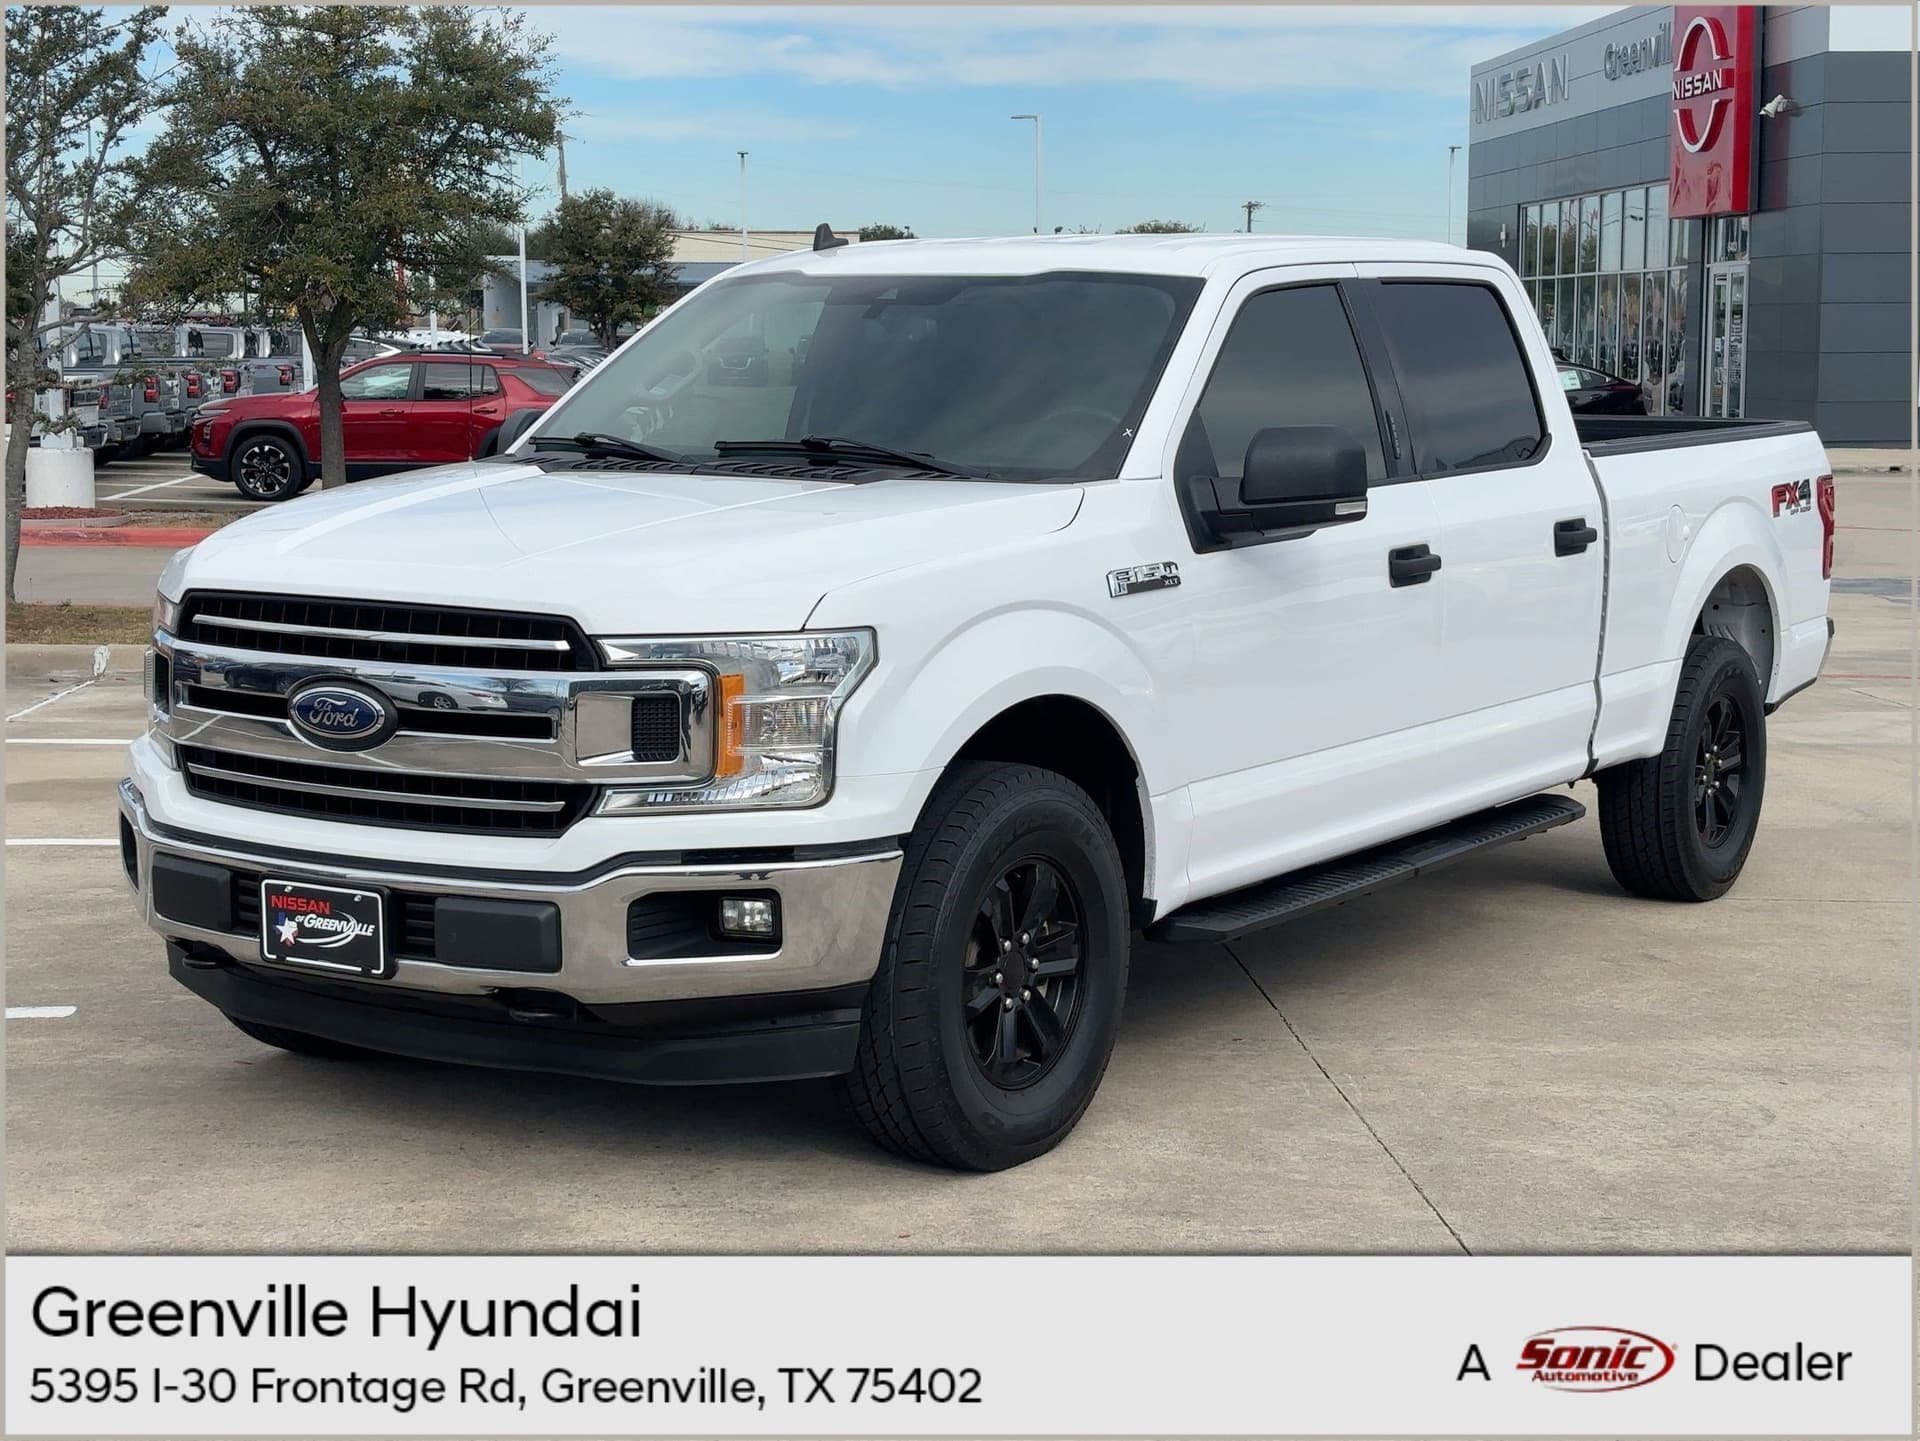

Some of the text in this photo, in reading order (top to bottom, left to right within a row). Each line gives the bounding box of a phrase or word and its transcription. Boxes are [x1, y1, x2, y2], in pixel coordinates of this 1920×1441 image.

[1604, 21, 1672, 81] Greenvill
[1475, 53, 1569, 124] NISSAN
[1672, 68, 1722, 100] NISSAN
[1772, 478, 1811, 518] FX4
[1164, 578, 1179, 586] XLT
[309, 697, 359, 727] Ford
[271, 895, 331, 914] NISSAN
